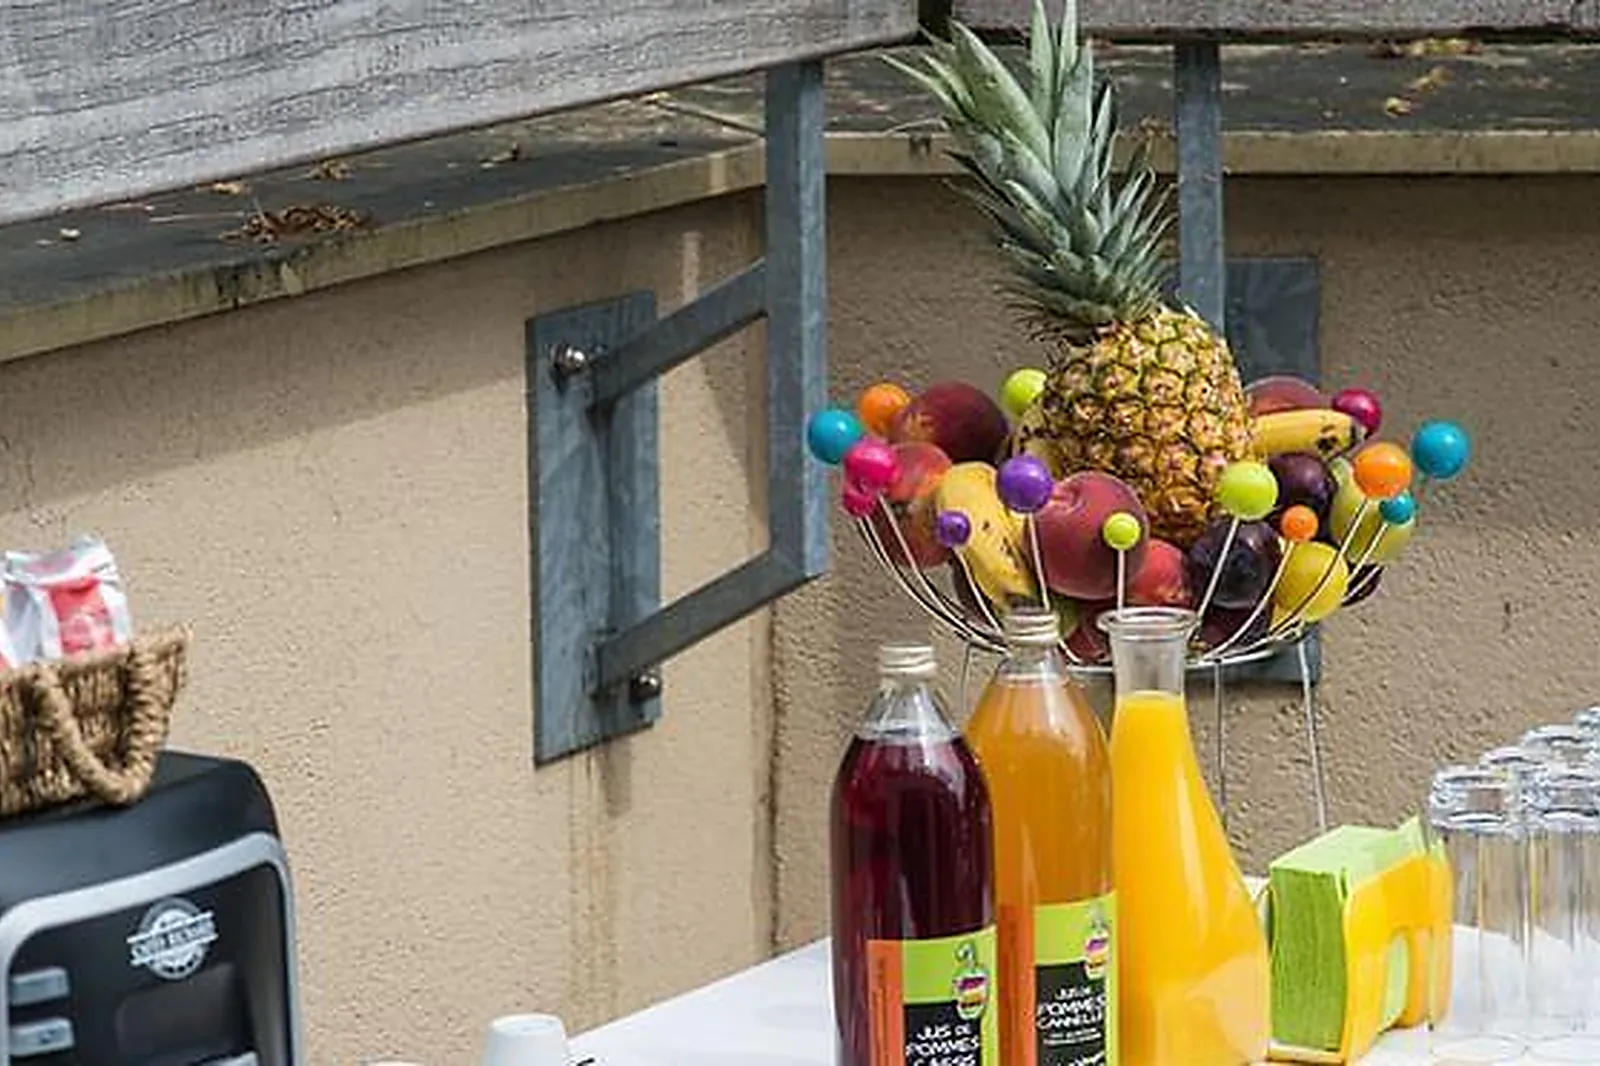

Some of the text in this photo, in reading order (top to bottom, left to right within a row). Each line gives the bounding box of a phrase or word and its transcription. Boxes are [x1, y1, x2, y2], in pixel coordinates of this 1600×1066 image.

[1037, 995, 1107, 1017] POMMES
[915, 1022, 973, 1041] JUS DE
[905, 1035, 980, 1057] POMMES
